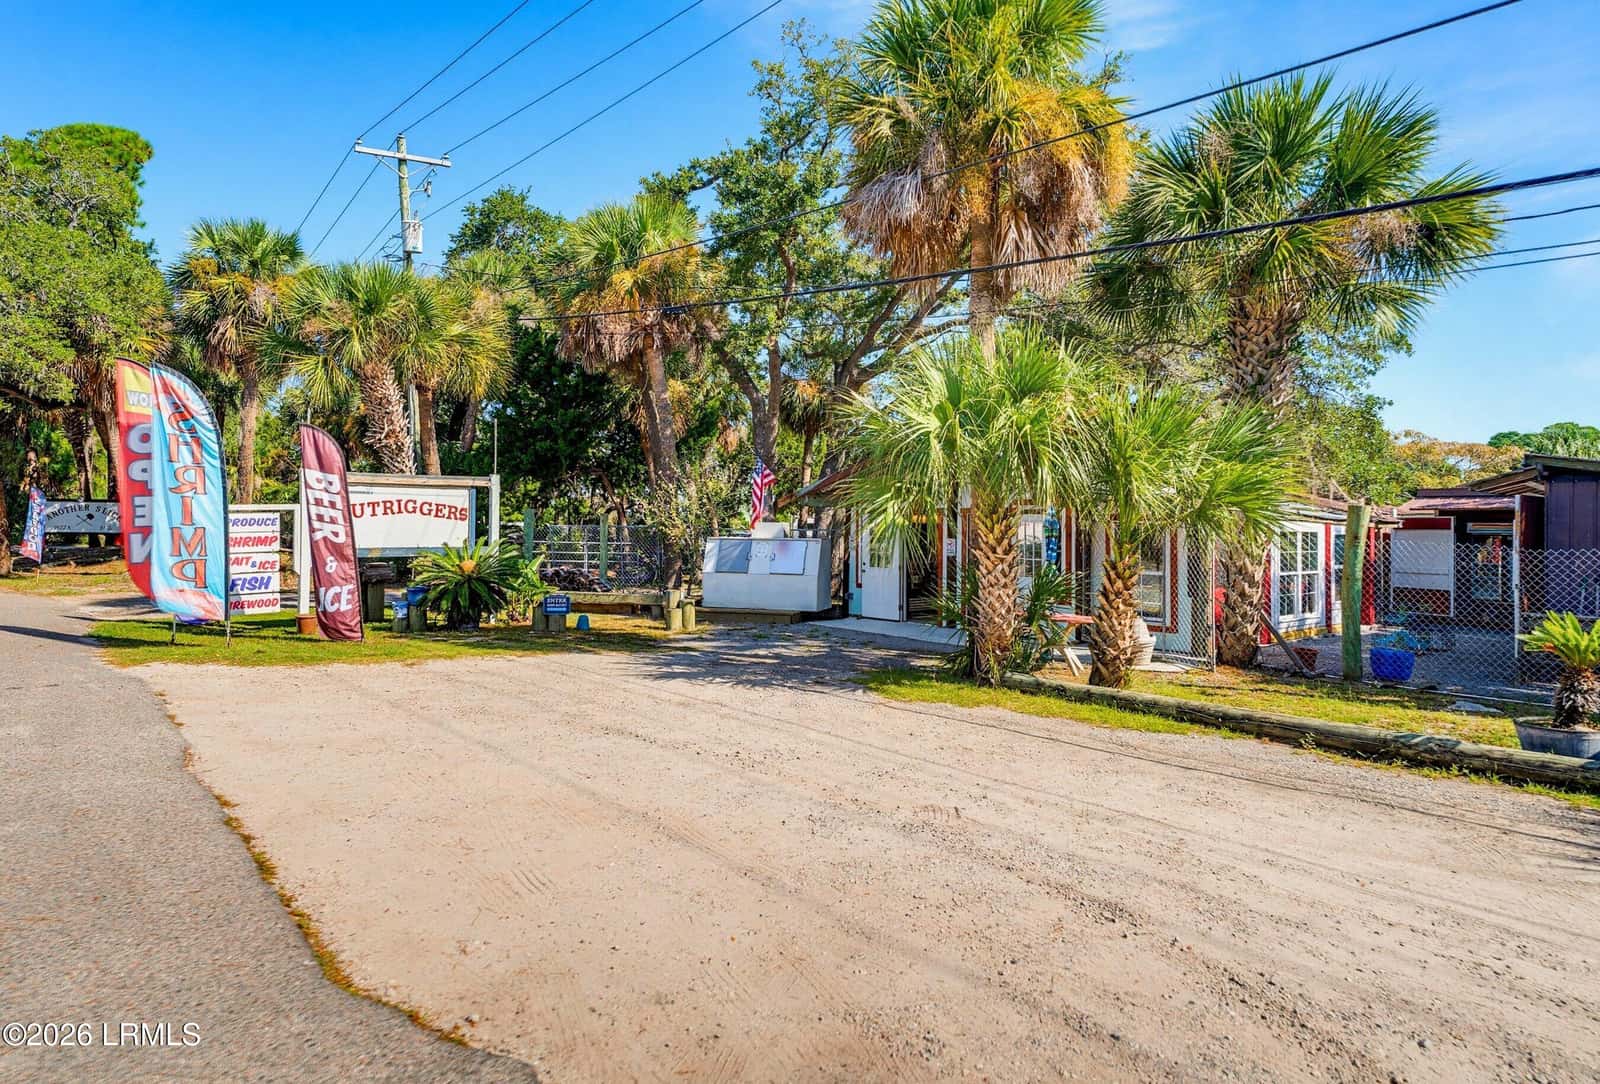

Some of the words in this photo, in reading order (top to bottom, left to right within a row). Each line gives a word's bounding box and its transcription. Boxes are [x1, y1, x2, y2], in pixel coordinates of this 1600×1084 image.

[46, 504, 90, 521] ANOTHER
[96, 505, 121, 522] SLIC
[304, 468, 346, 544] BEER
[351, 499, 468, 522] UTRIGGERS
[229, 517, 278, 528] RODUCE
[228, 556, 252, 566] AIT
[250, 560, 257, 569] &
[257, 560, 277, 571] ICE
[325, 556, 338, 573] &
[229, 575, 272, 592] FISH
[228, 598, 279, 611] IREWOOD
[319, 583, 354, 613] ICE
